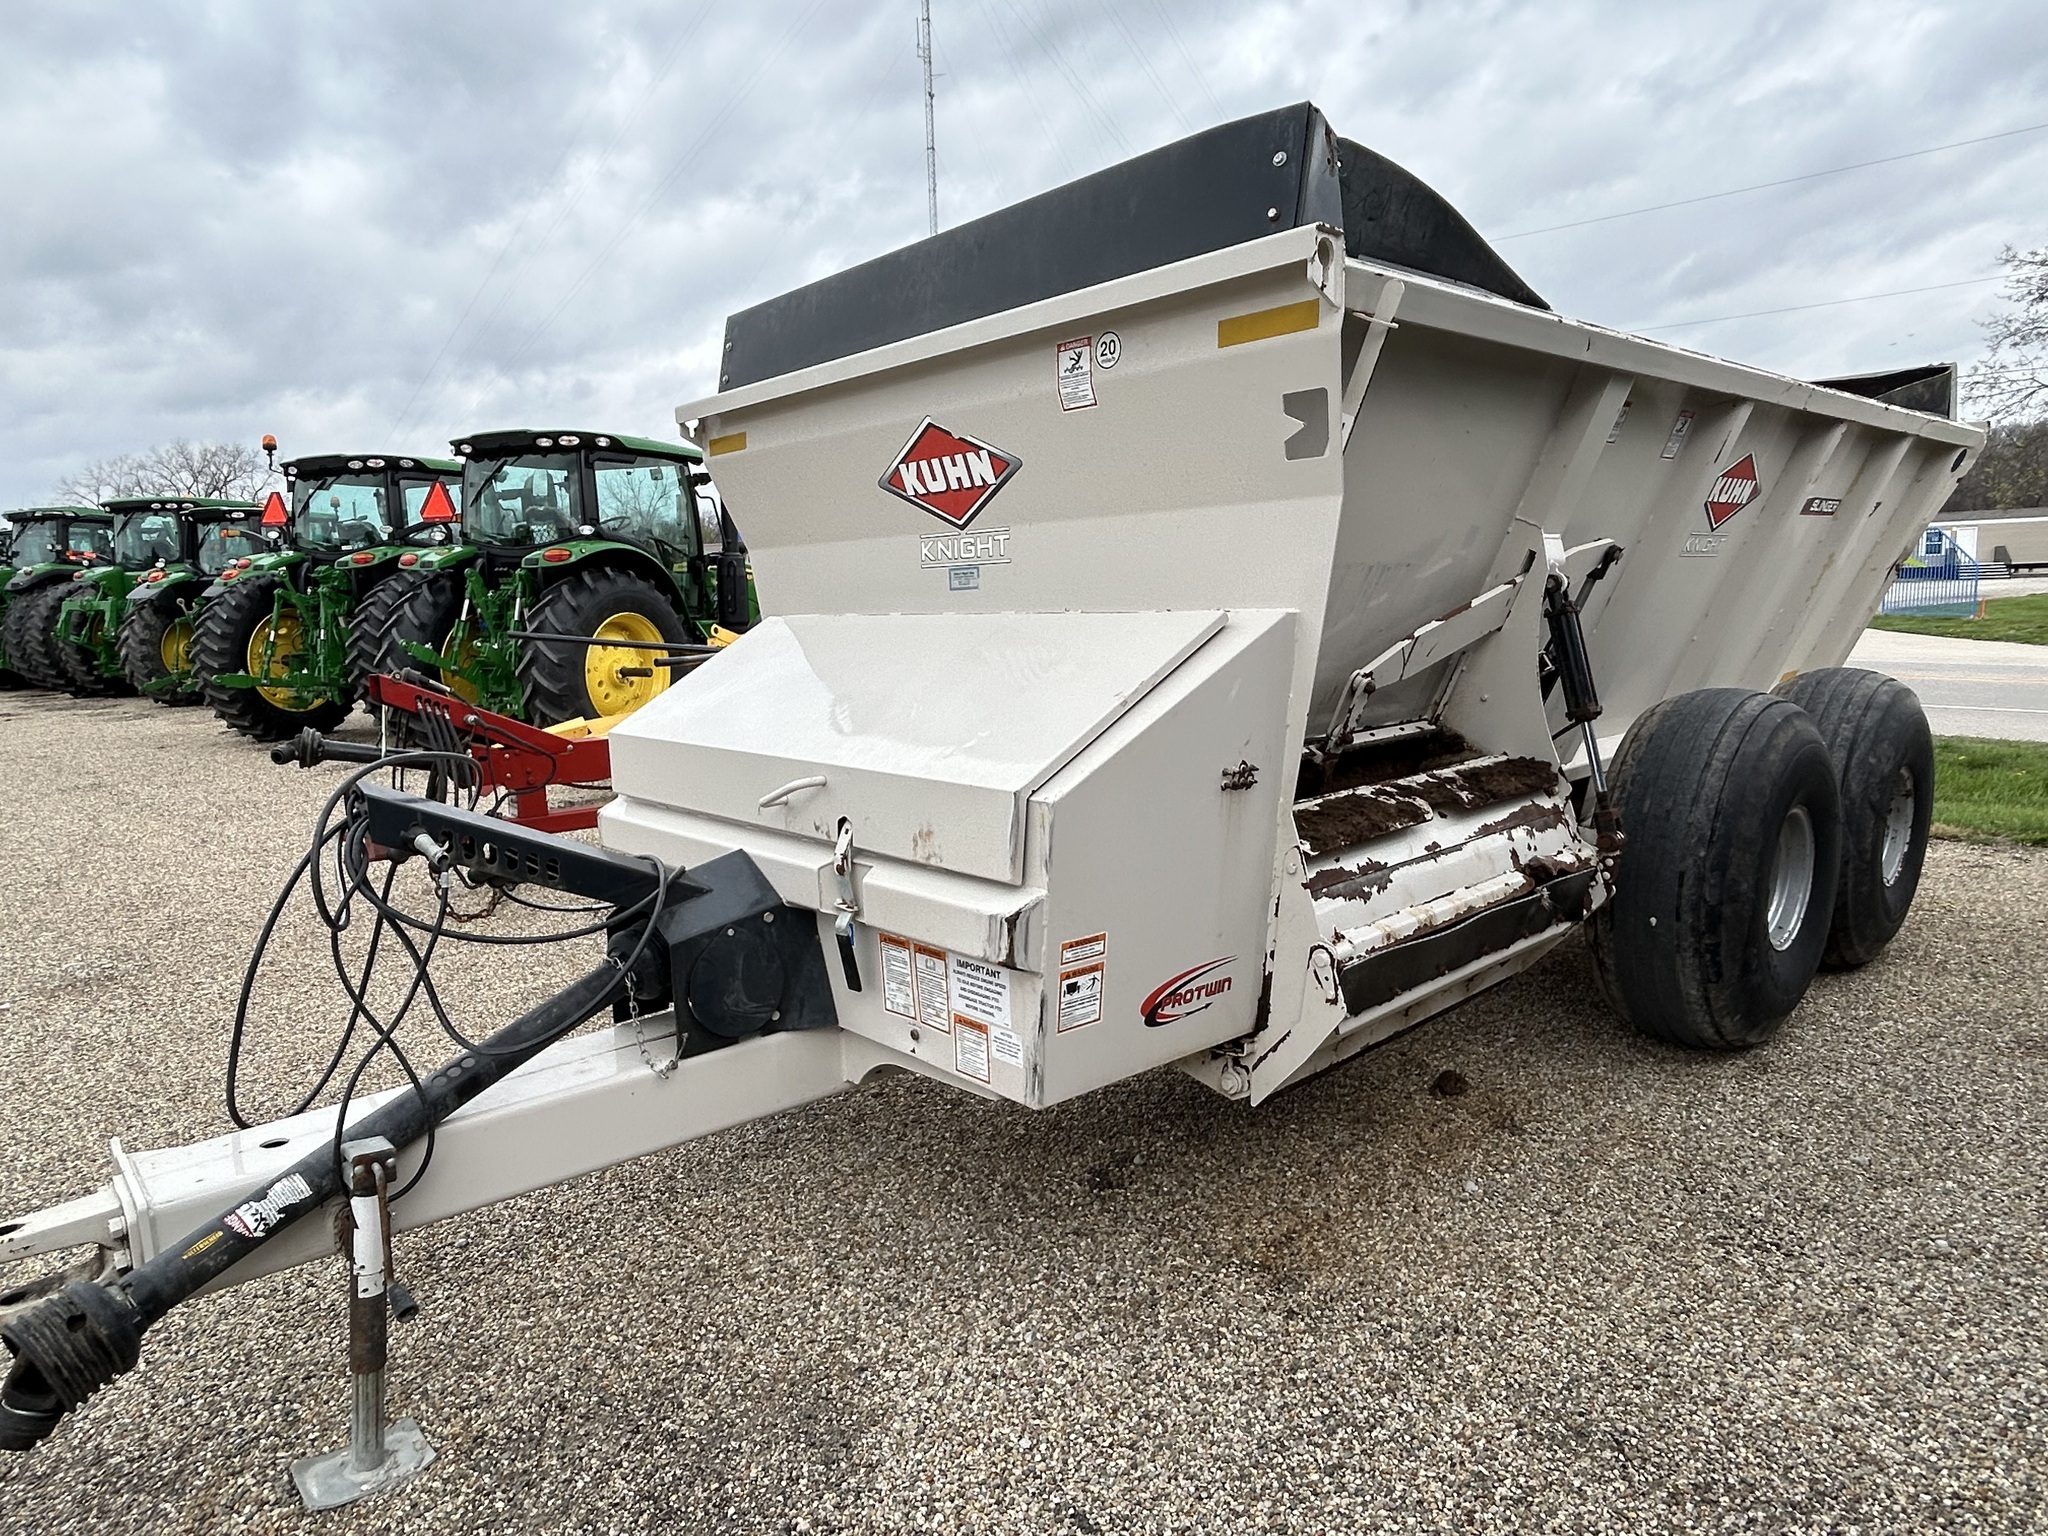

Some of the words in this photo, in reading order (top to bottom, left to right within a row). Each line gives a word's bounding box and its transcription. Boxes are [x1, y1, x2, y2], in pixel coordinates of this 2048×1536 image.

[1100, 339, 1116, 357] 20
[898, 449, 997, 497] KUHN
[1707, 476, 1757, 504] KUHN
[920, 534, 1010, 562] KNIGHT
[956, 958, 1001, 979] IMPORTANT
[1161, 977, 1232, 1012] PROTWIN
